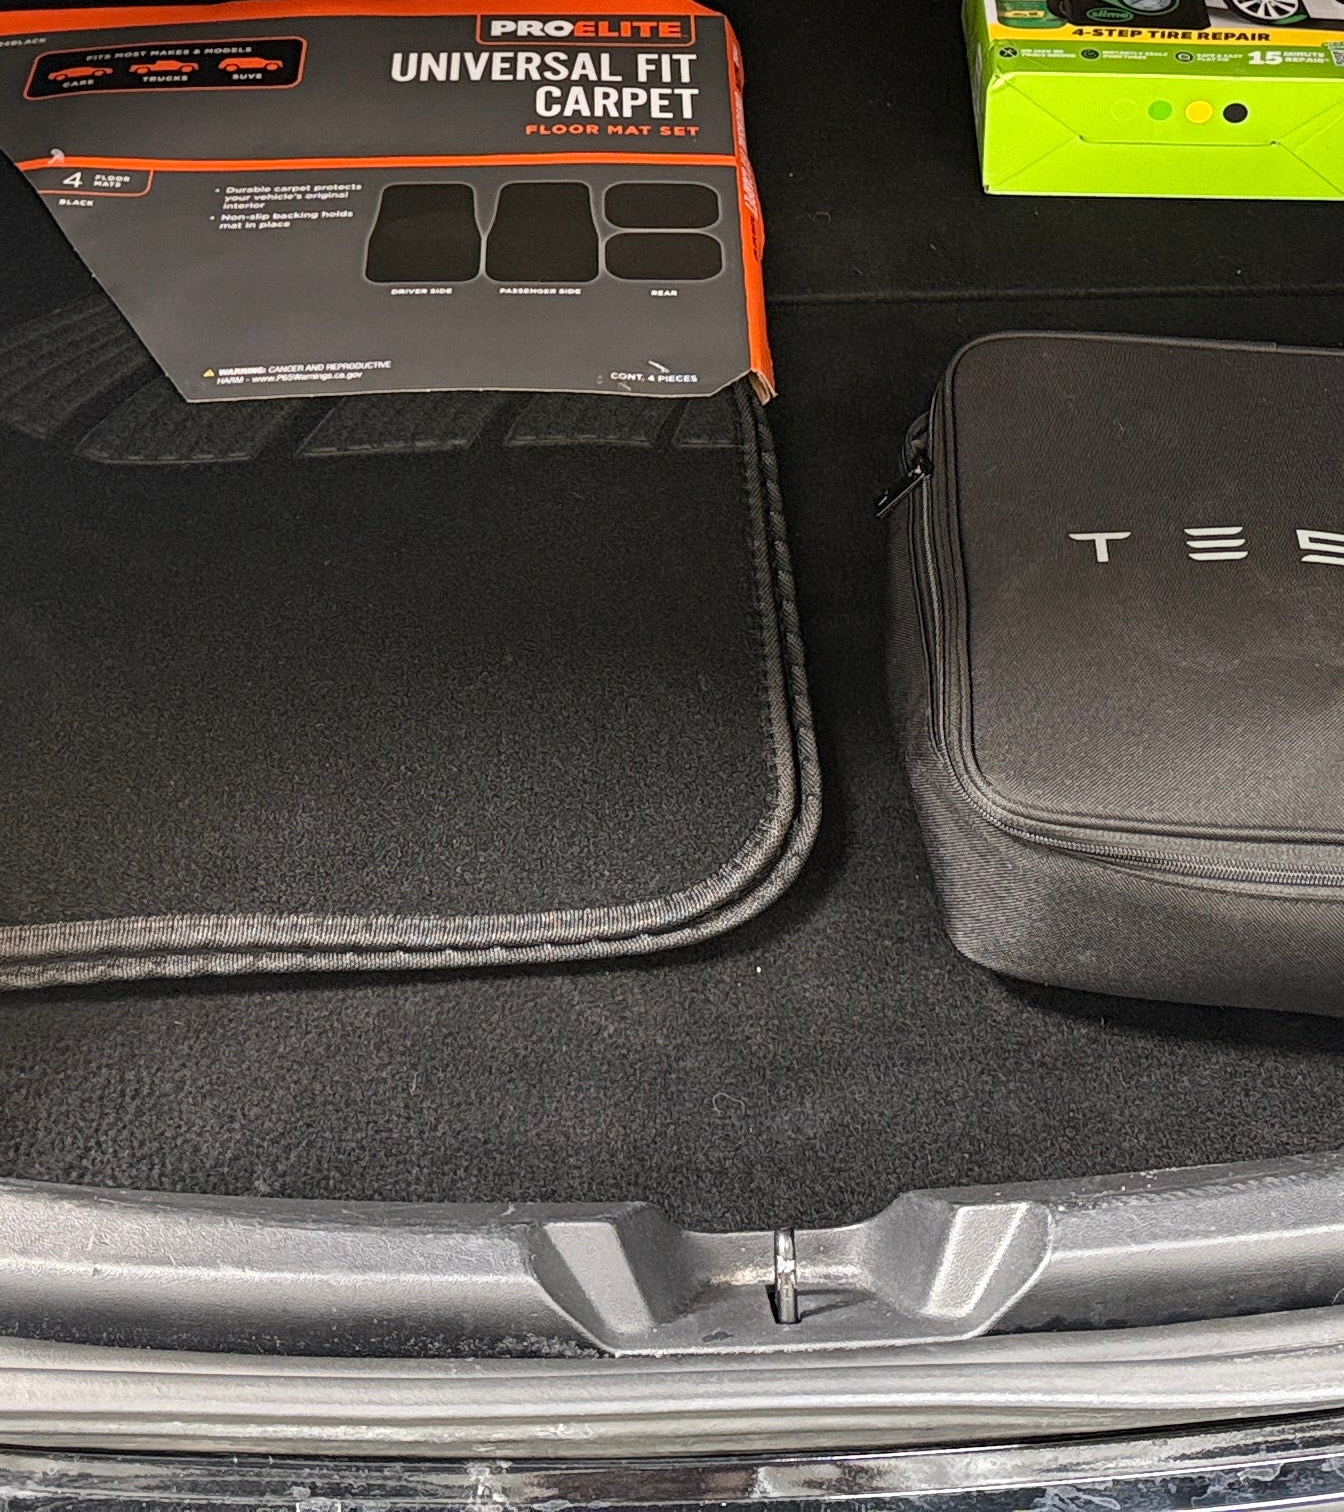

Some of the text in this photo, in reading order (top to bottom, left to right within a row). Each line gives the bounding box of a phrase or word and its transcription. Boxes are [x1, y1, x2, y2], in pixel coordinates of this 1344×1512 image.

[490, 20, 682, 38] PROELITE
[1072, 28, 1271, 41] 4-STEP TIRE REPAIR
[86, 54, 111, 62] FITS
[114, 50, 147, 59] MOST
[150, 48, 190, 56] MAKES
[204, 46, 253, 55] MODELS
[1248, 51, 1283, 65] 15
[391, 51, 623, 83] UNIVERSAL
[636, 53, 698, 84] FIT
[142, 74, 188, 83] TRUCKS
[231, 72, 263, 81] SUVS
[62, 78, 94, 88] CARS
[535, 85, 700, 119] CARPET
[525, 124, 700, 137] FLOOR MAT SET
[62, 171, 83, 189] 4
[94, 174, 131, 183] FLOOR
[225, 183, 363, 194] Durable carpet protects
[58, 198, 94, 207] BLACK
[224, 191, 350, 203] your vehicle's original
[222, 201, 266, 210] interior
[221, 210, 354, 223] Non-slip backing holds
[219, 220, 291, 230] mat in place
[650, 289, 678, 297] REAR
[218, 360, 392, 376] WARNING: CANCER AND REPRODUCTIVE
[216, 376, 244, 385] HARM
[647, 374, 656, 382] 4
[657, 374, 699, 383] PIECES
